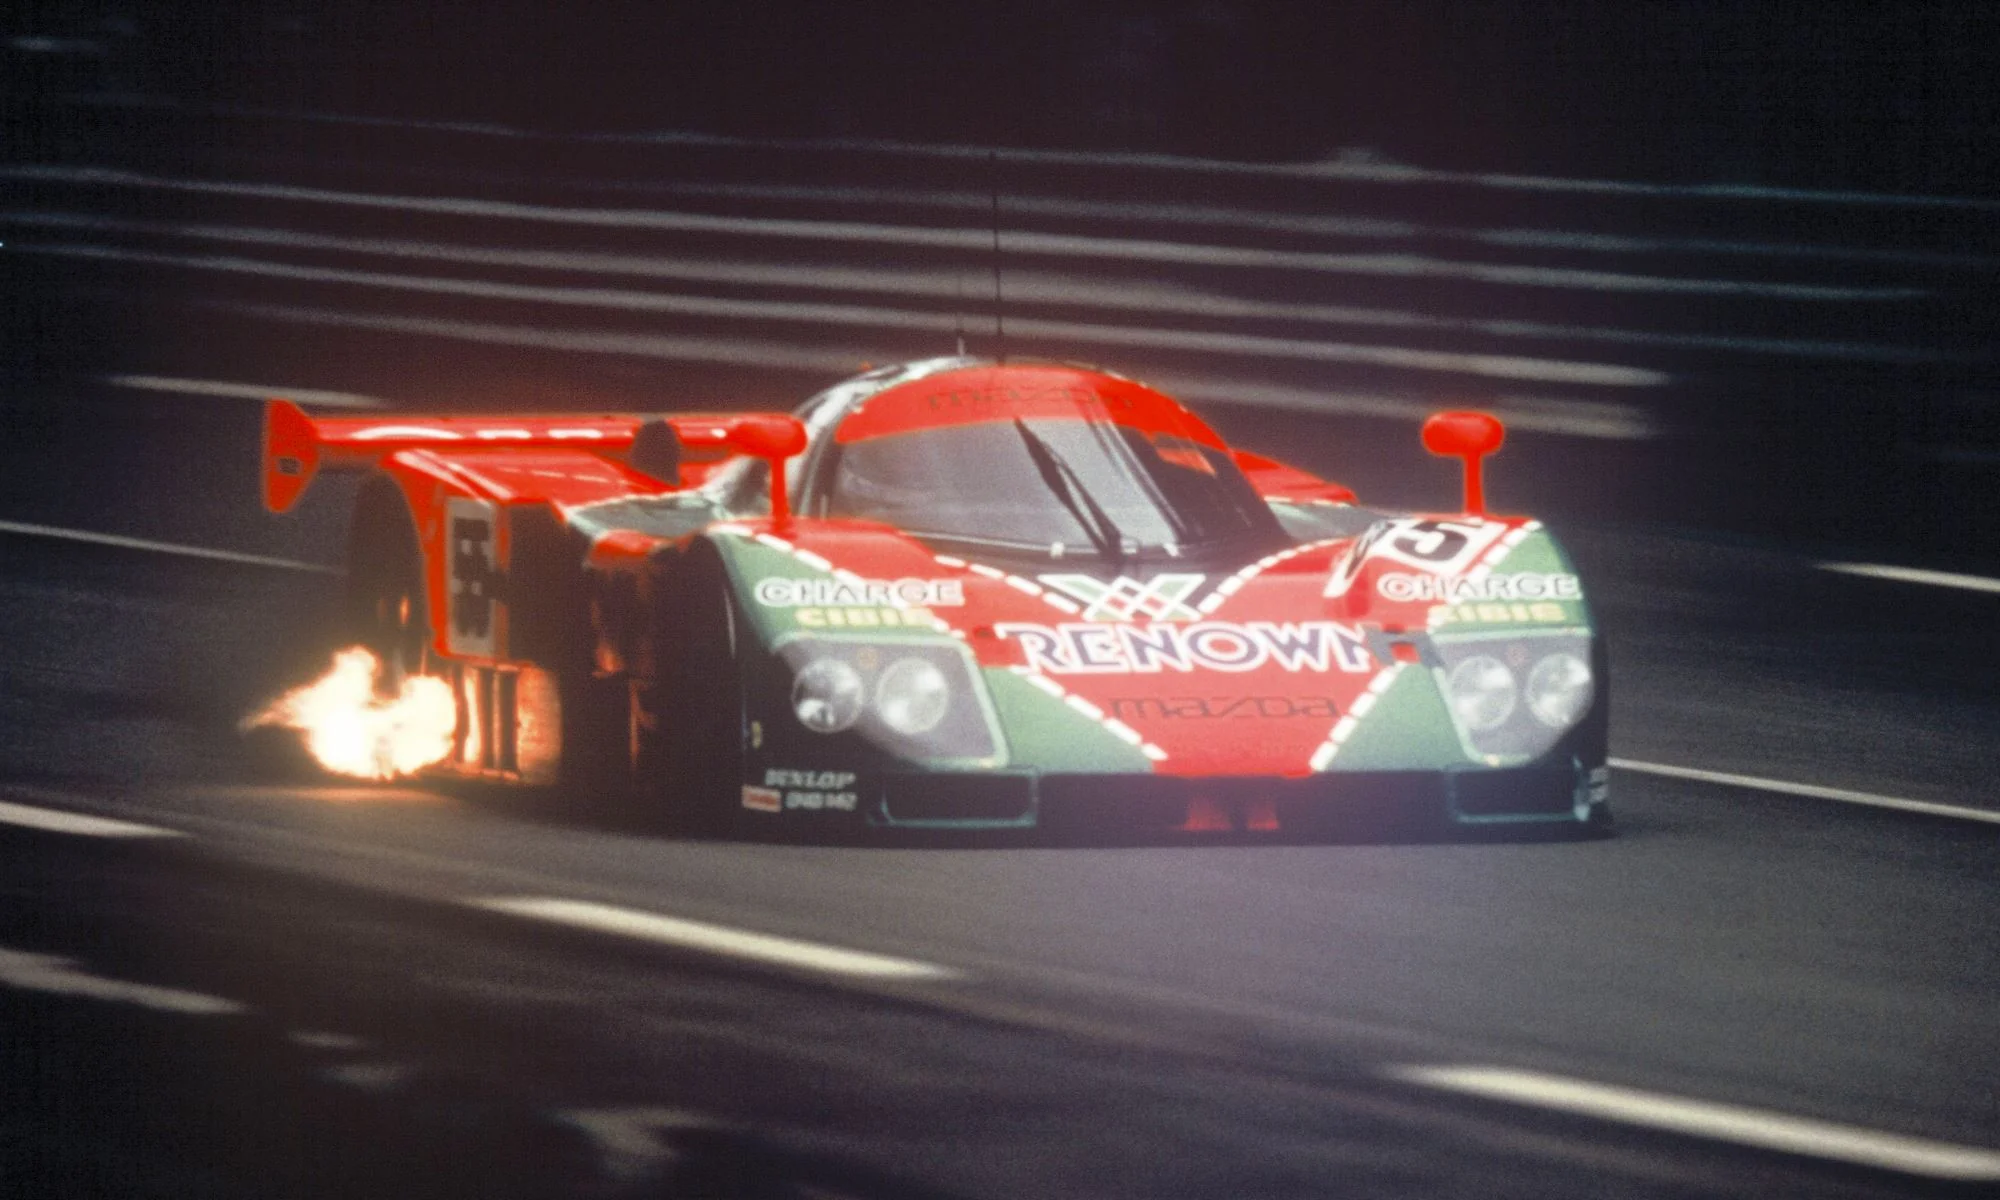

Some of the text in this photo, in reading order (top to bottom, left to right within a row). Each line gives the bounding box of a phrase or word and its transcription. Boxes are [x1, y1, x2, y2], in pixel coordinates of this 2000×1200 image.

[755, 577, 965, 607] CHARGE
[1377, 571, 1583, 601] CHARGE
[995, 621, 1373, 674] RENOWN
[1108, 695, 1343, 720] mazda
